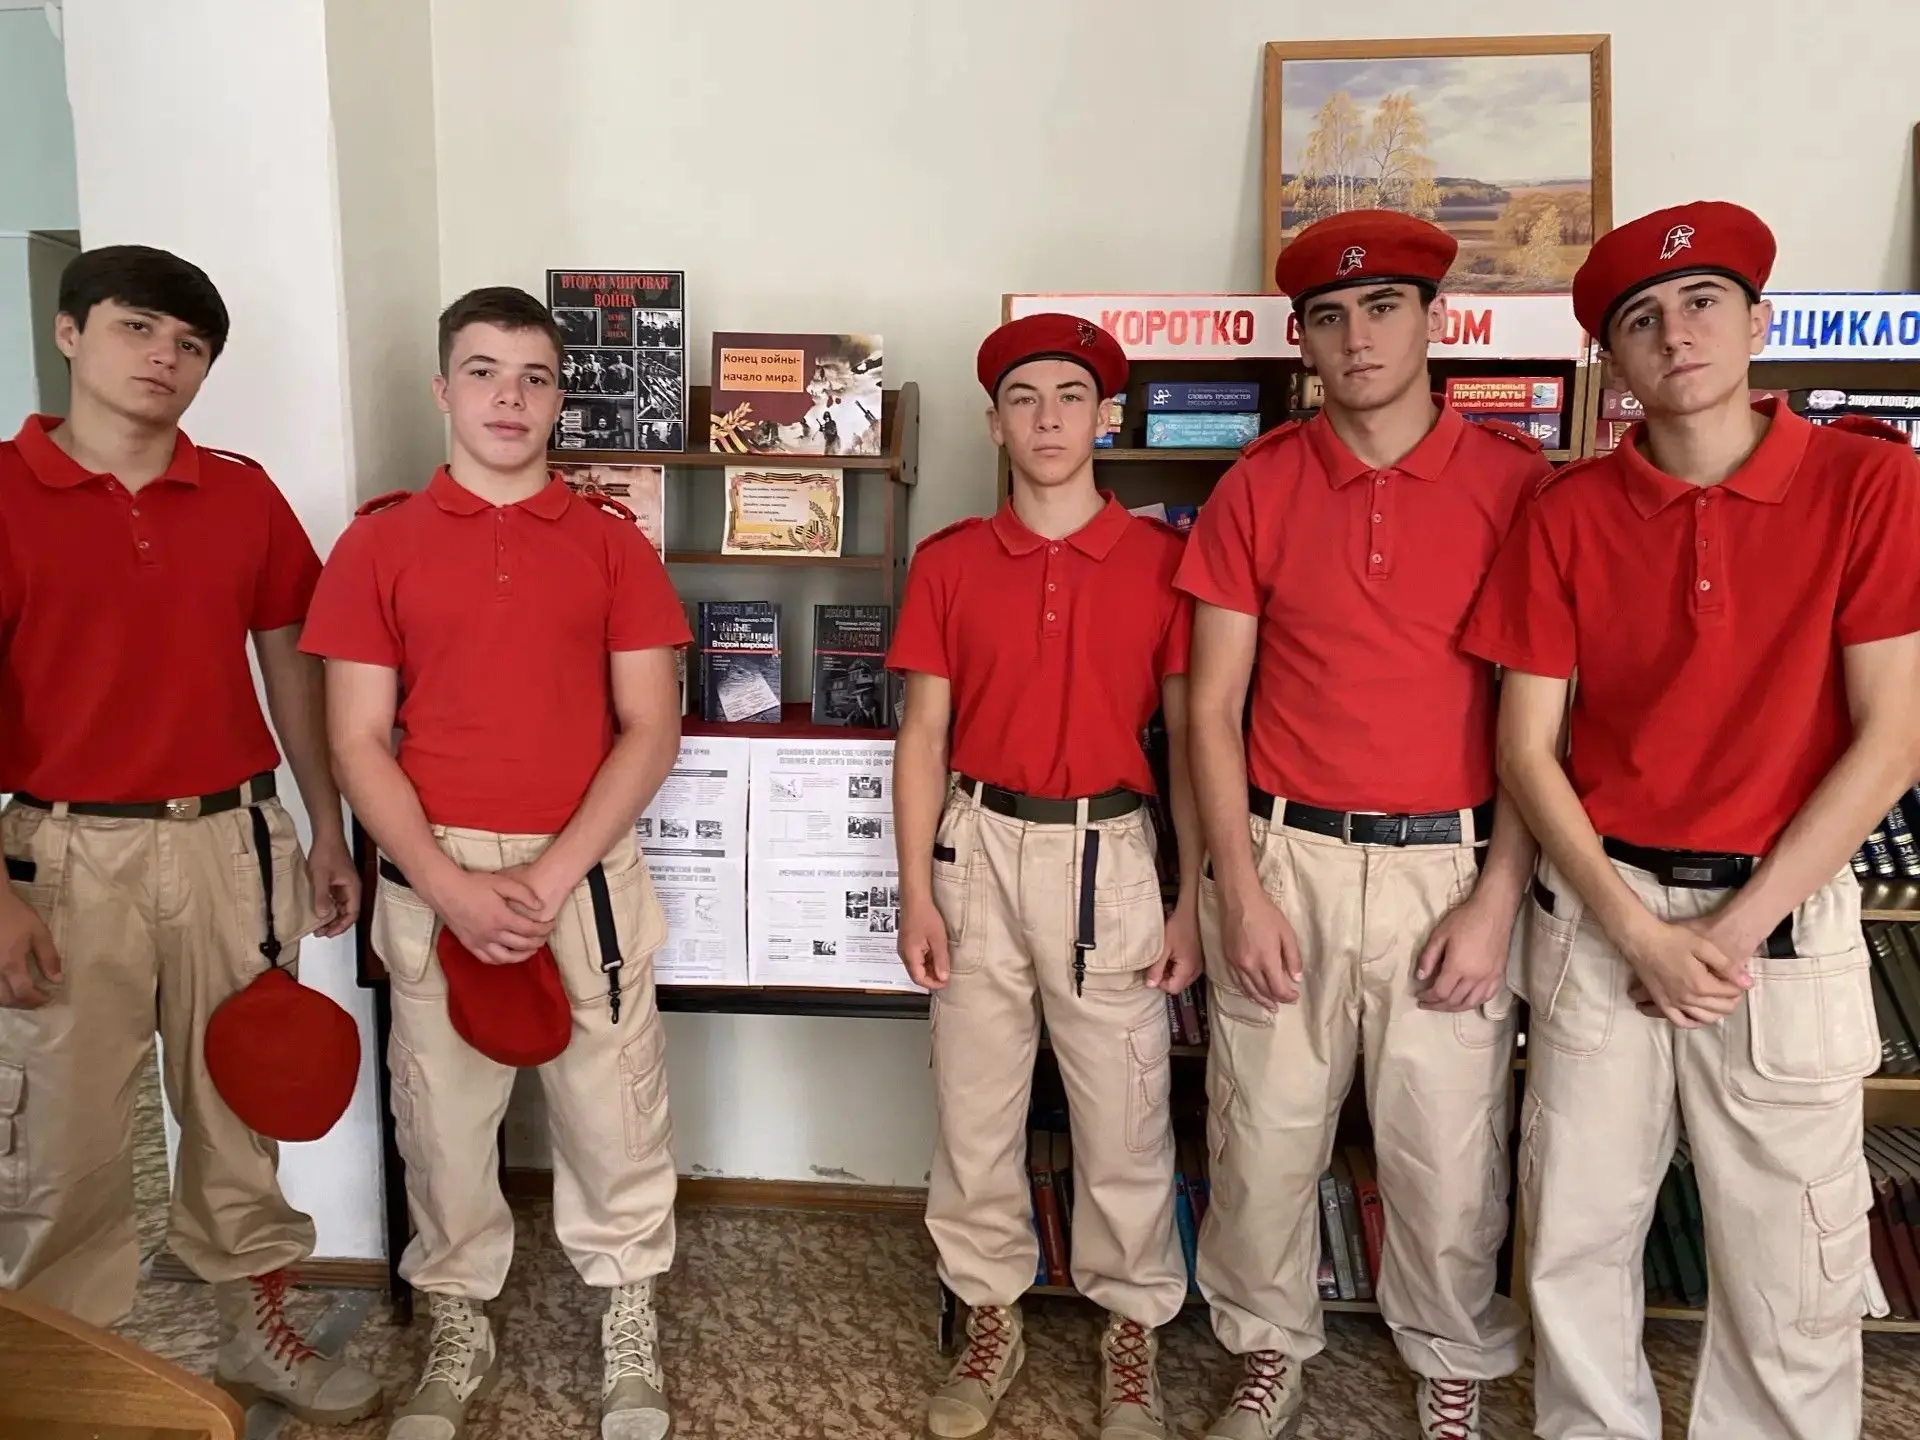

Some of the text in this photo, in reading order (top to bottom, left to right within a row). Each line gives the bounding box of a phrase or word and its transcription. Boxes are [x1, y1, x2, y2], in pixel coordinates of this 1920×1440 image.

[561, 275, 669, 290] ВТОРАЯ МИРОВАЯ
[593, 290, 637, 307] ВОЙНА
[1101, 310, 1254, 346] КОРОТКО
[723, 353, 801, 366] Конец войны-
[723, 373, 797, 384] начало мира.
[1453, 390, 1526, 400] ПРЕПАРАТЫ
[1451, 400, 1481, 408] ПОЛНЫЙ
[712, 640, 774, 650] Второй мировой
